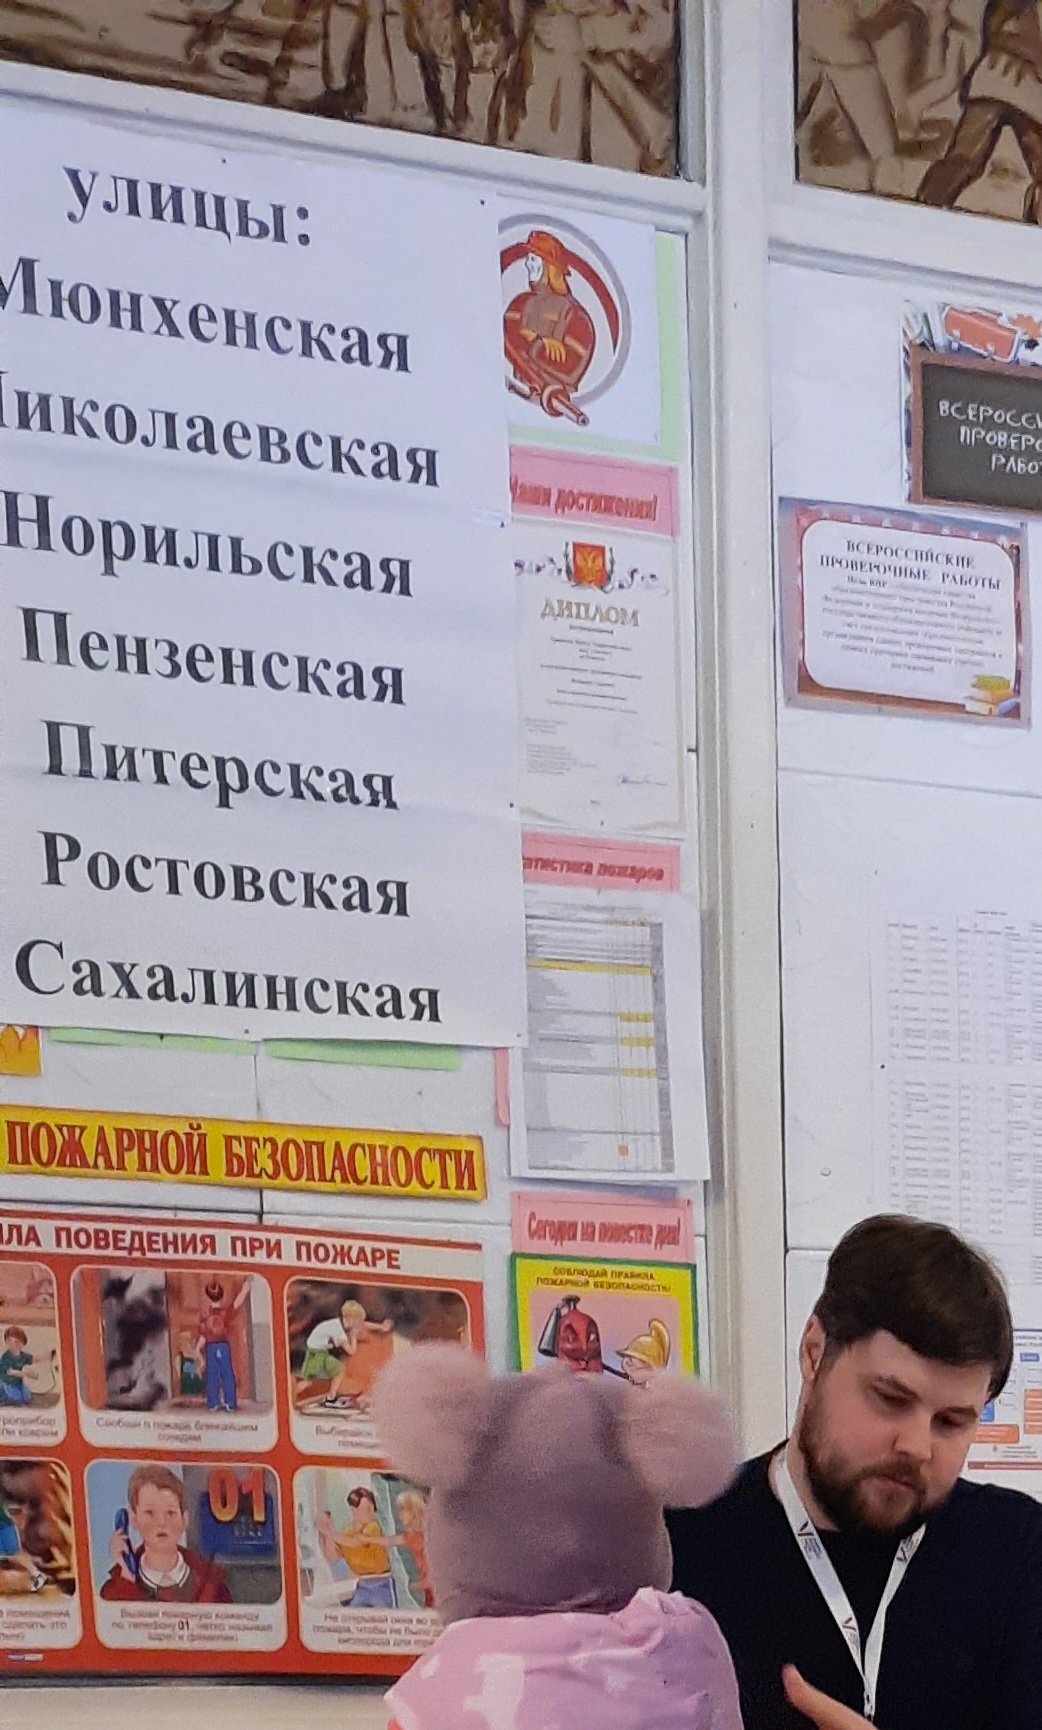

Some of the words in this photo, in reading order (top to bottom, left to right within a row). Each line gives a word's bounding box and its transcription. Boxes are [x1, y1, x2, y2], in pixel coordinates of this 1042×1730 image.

[63, 165, 311, 246] улицы:
[0, 255, 412, 374] Мюнхенская
[0, 370, 440, 488] иколаевская
[1, 489, 414, 599] Норильская
[820, 554, 930, 581] ПРОВЕРОЧНЫЕ
[942, 572, 1000, 591] РАБОТЫ
[19, 605, 406, 706] Пензенская
[541, 598, 639, 627] ДИПЛОМ
[41, 718, 400, 811] Питерская
[37, 829, 411, 918] Ростовская
[14, 938, 443, 1024] Сахалинская
[7, 1120, 210, 1176] ПОЖАРНОЙ
[222, 1134, 477, 1191] БЕЗОПАСНОСТИ
[55, 1226, 217, 1256] ПОВЕДЕНИЯ
[231, 1236, 283, 1259] ПРИ
[296, 1241, 401, 1269] ПОЖАРЕ
[207, 1466, 267, 1523] 01
